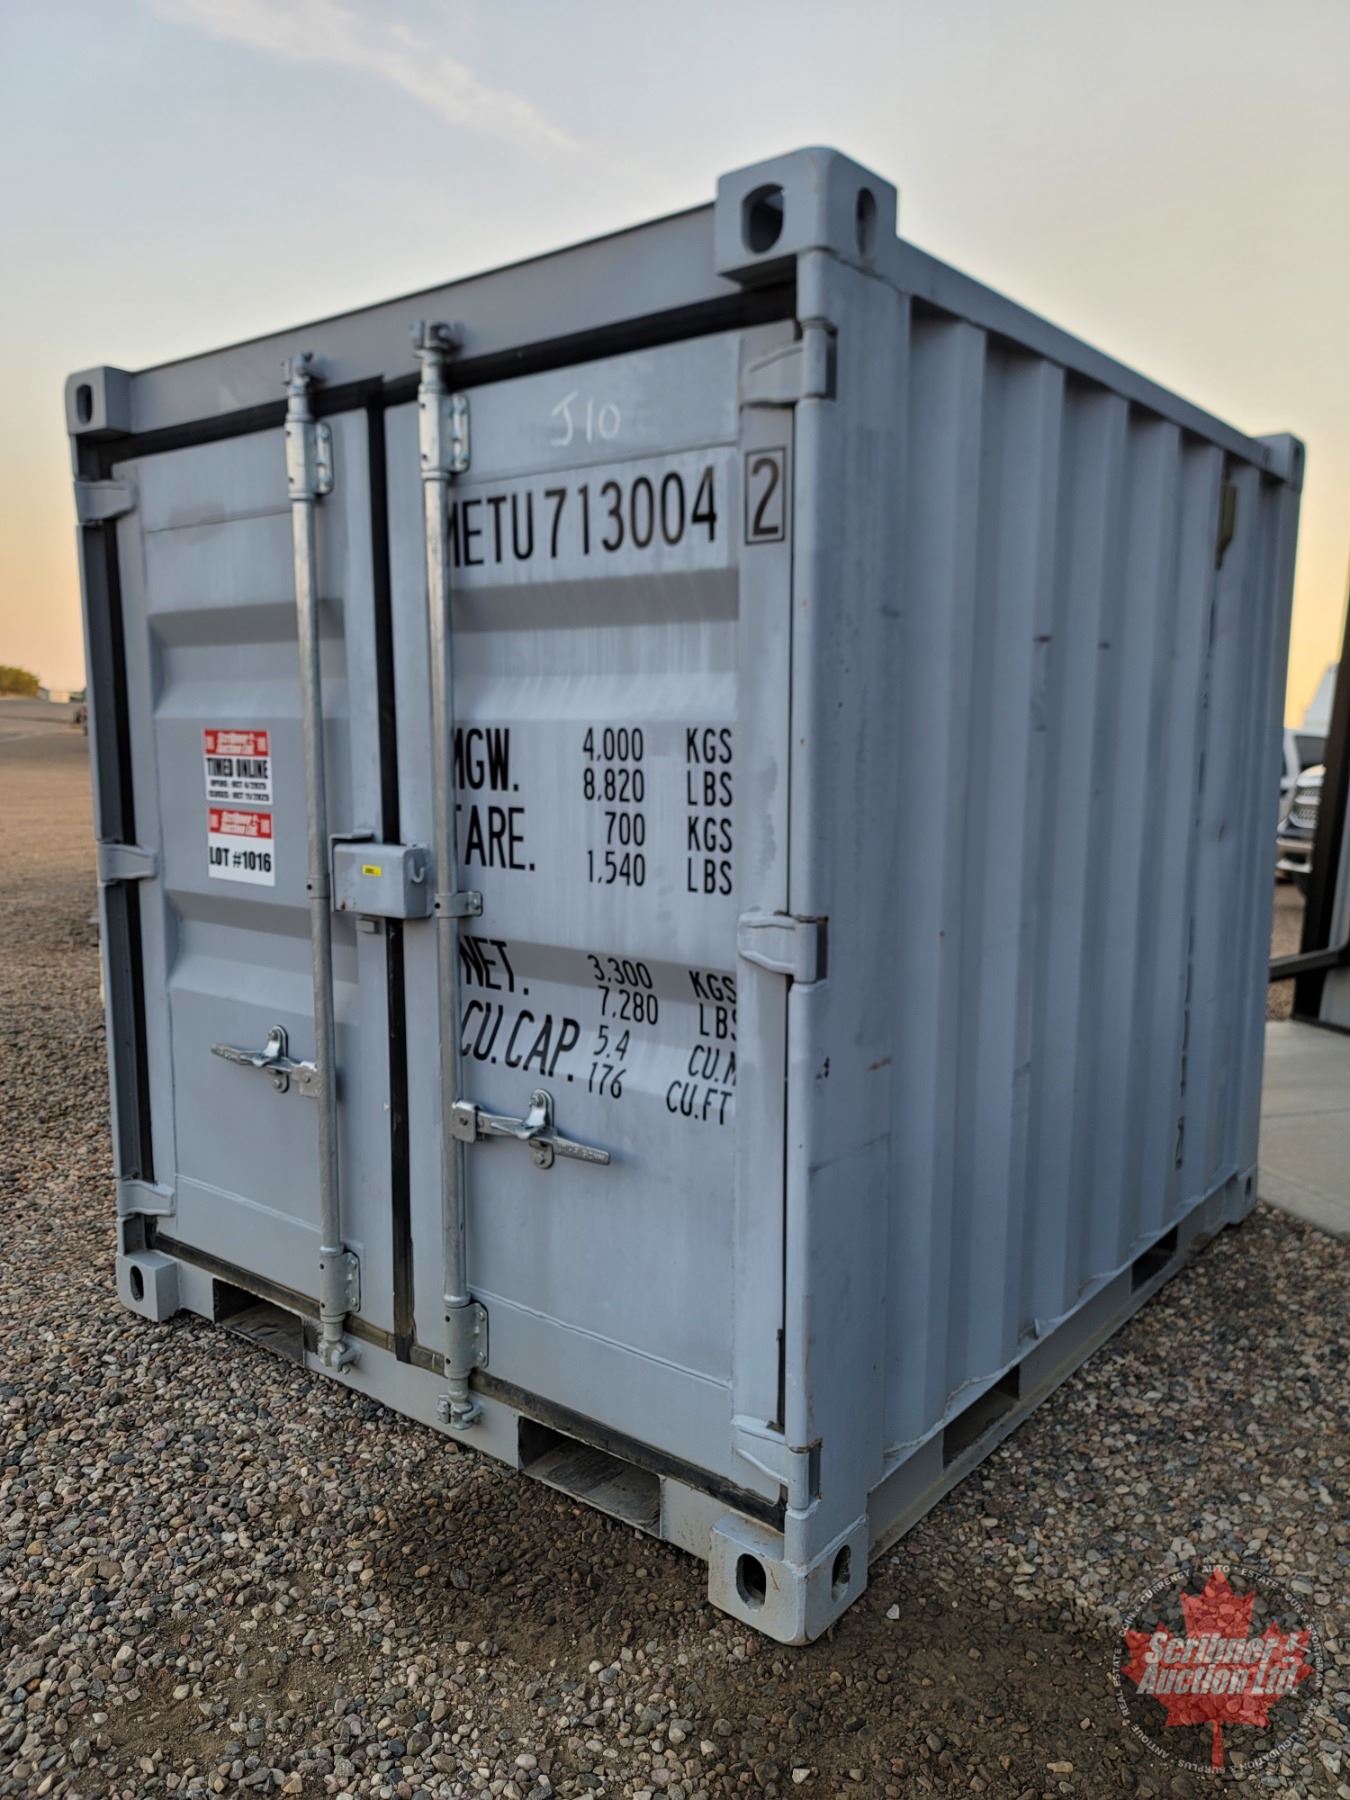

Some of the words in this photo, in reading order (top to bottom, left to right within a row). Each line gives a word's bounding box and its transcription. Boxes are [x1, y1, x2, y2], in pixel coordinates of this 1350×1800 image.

[550, 391, 621, 446] J10
[751, 457, 780, 536] 2
[686, 727, 733, 764] KGS
[687, 770, 733, 807] LBS
[455, 804, 536, 871] ARE.
[604, 812, 646, 846] 700
[687, 816, 733, 853] KGS
[209, 846, 229, 867] LOT
[232, 850, 272, 873] #1016
[687, 857, 733, 895] LBS
[688, 970, 737, 1004] KGS
[593, 1024, 630, 1061] 5.4
[588, 1061, 628, 1099] 176
[665, 1080, 733, 1126] CU.FT
